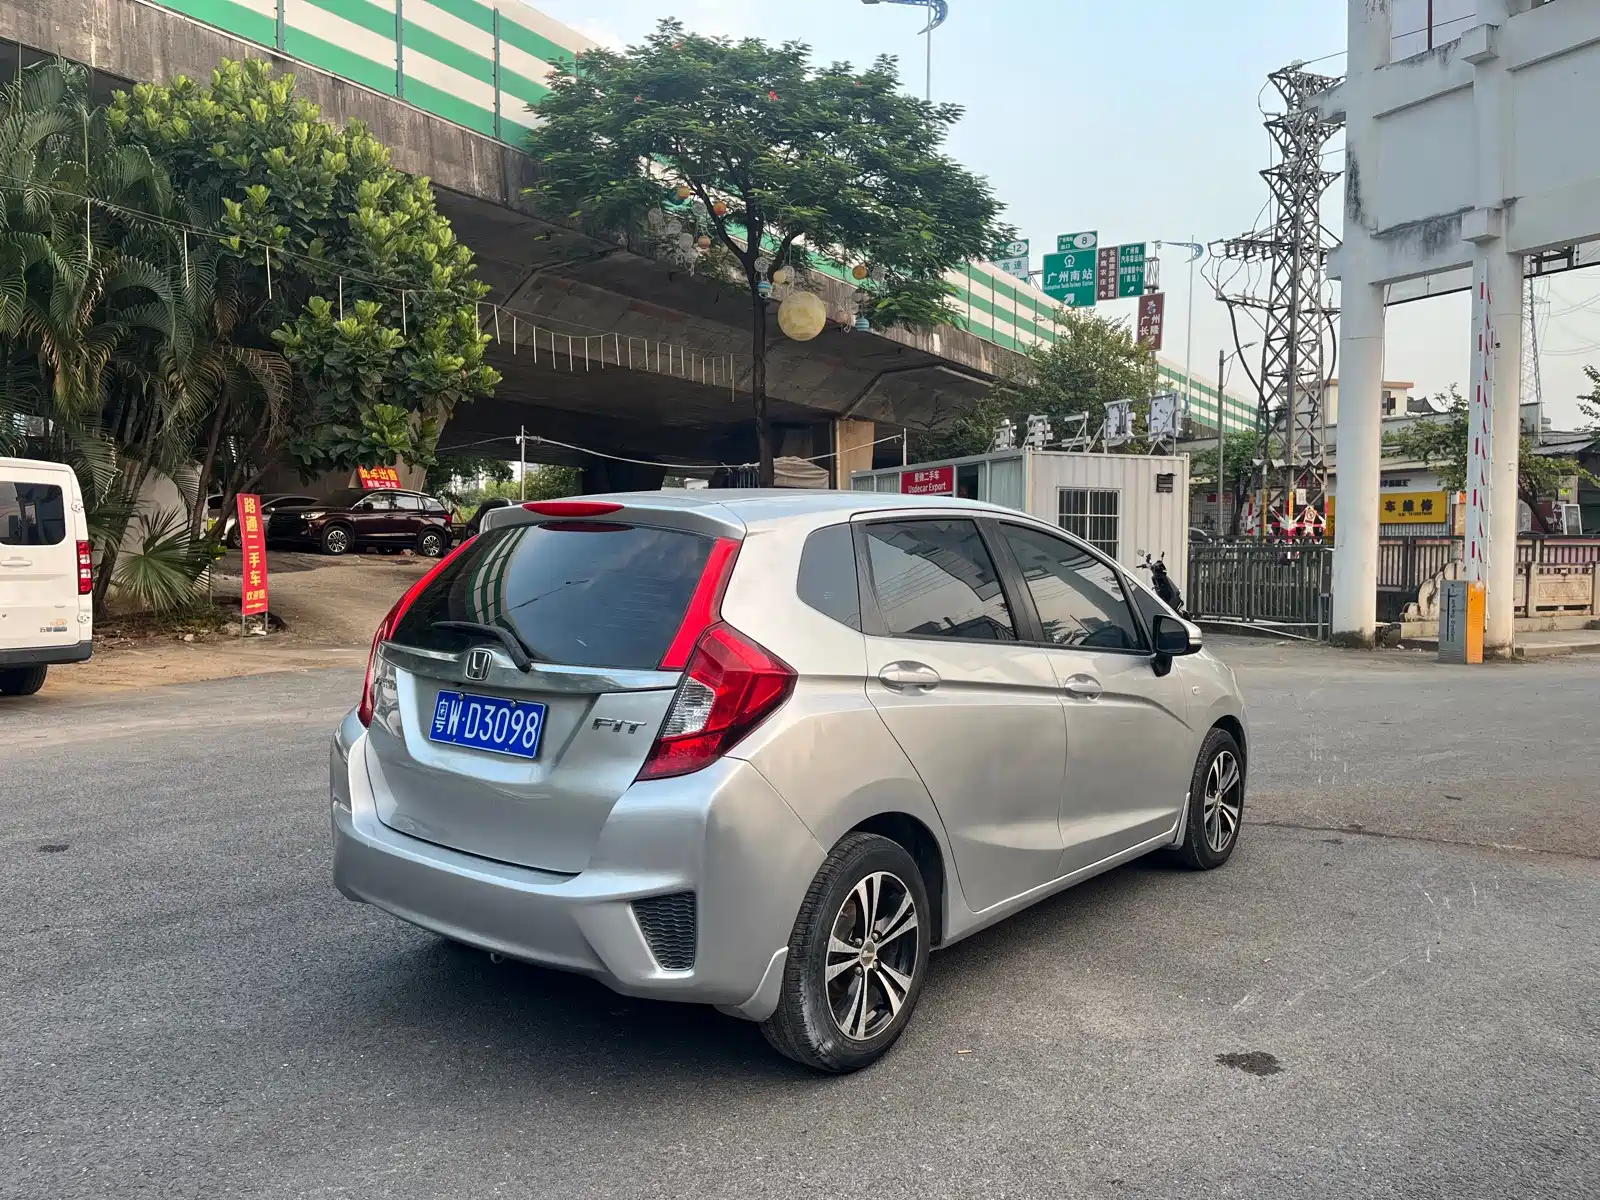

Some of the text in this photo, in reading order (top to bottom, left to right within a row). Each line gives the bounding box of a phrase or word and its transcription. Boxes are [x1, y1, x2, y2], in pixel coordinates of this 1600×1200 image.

[1081, 237, 1088, 245] 8
[1013, 244, 1022, 252] 12
[1047, 268, 1093, 284] 广州南站
[1140, 314, 1160, 325] 广州
[929, 481, 946, 492] Export
[243, 497, 262, 586] 路通二手车
[592, 717, 647, 734] FIT
